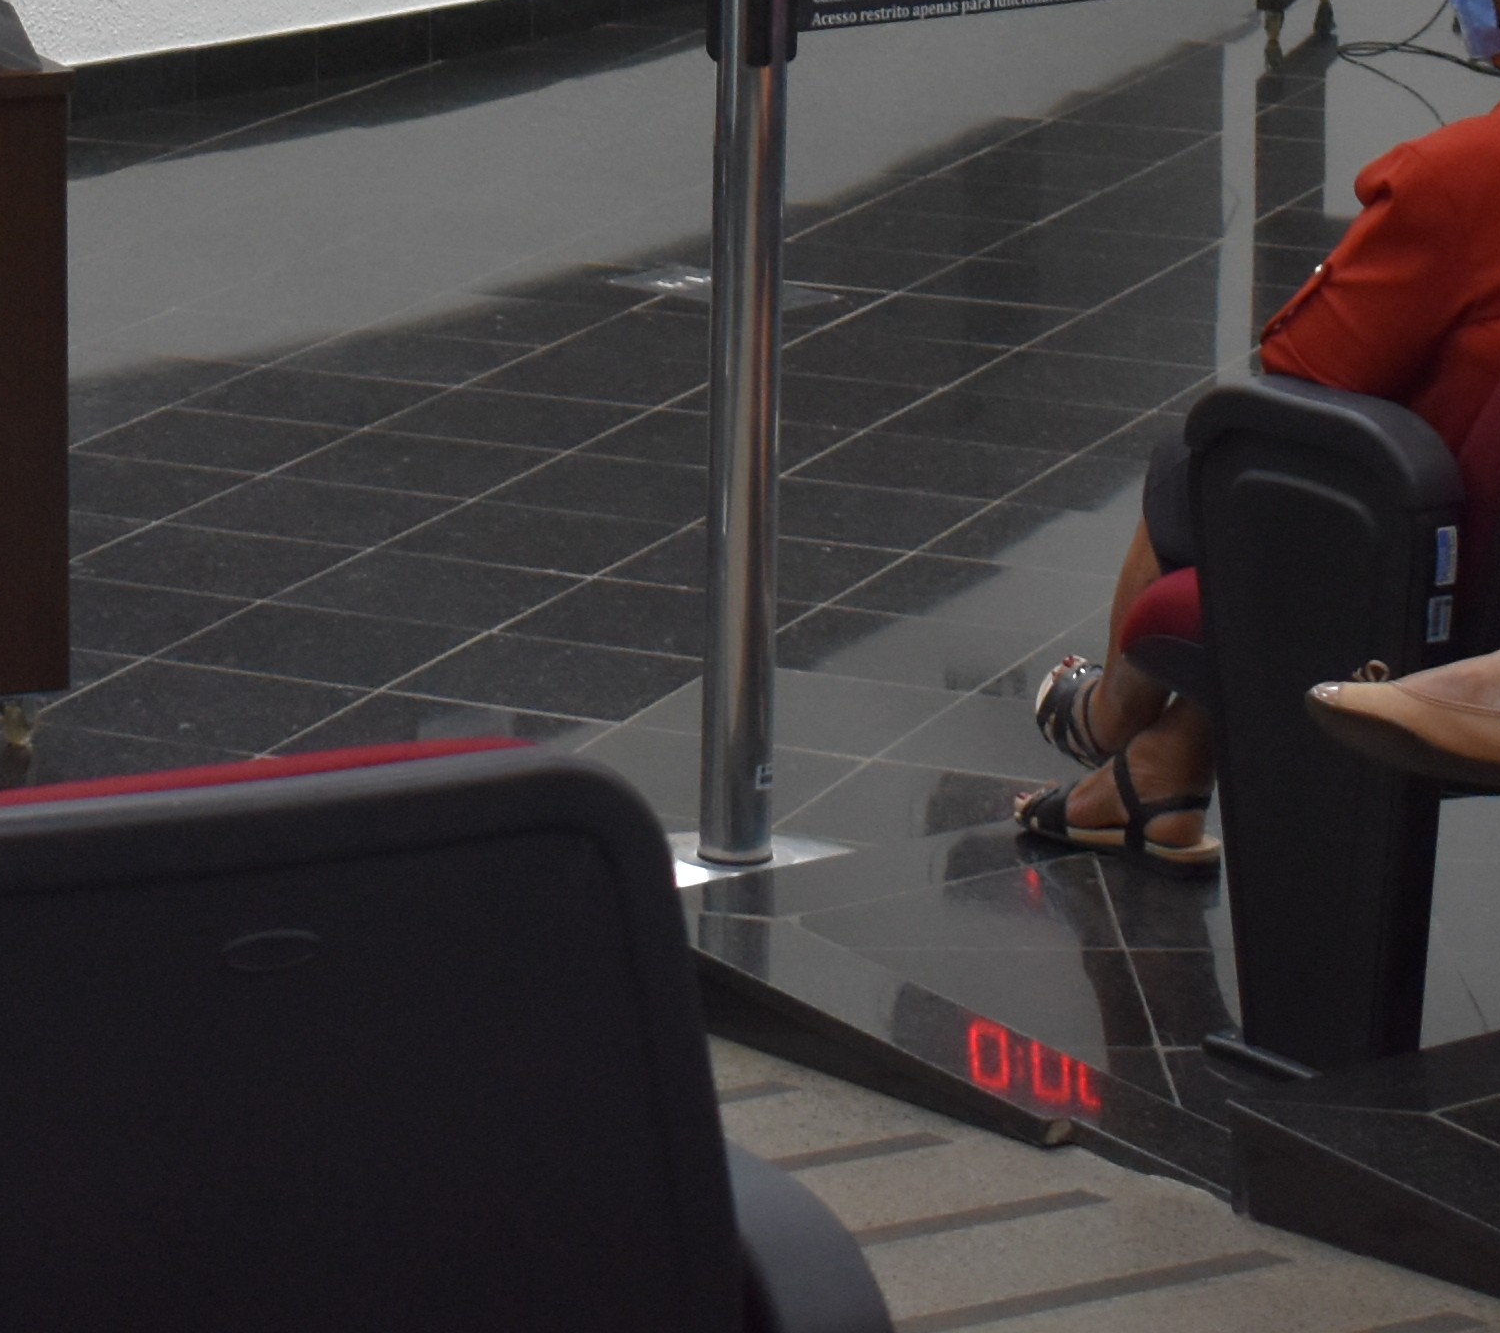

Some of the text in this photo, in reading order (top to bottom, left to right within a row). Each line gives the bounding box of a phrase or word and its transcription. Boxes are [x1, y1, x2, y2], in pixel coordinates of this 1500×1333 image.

[811, 11, 857, 27] Acesso
[860, 4, 910, 23] restrito
[912, 0, 959, 21] apenas
